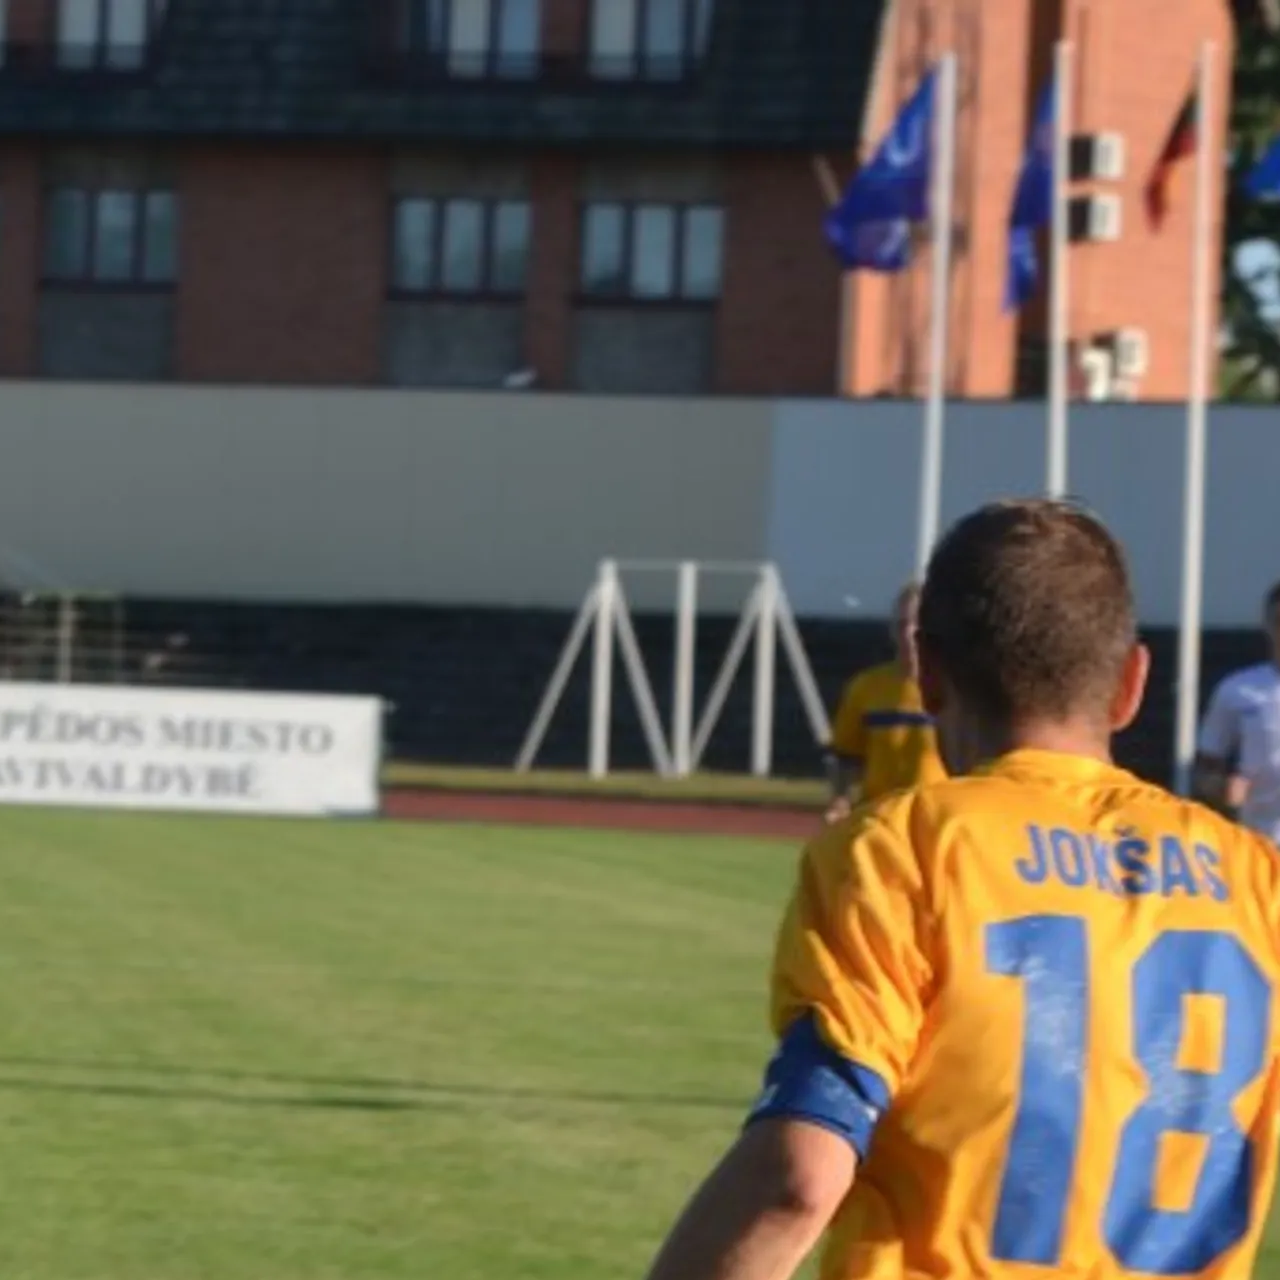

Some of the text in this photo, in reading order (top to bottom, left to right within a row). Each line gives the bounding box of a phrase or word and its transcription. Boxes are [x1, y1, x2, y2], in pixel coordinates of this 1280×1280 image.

[156, 712, 335, 754] MIESTO
[1015, 824, 1230, 903] JOKŠAS
[984, 912, 1272, 1276] 18
